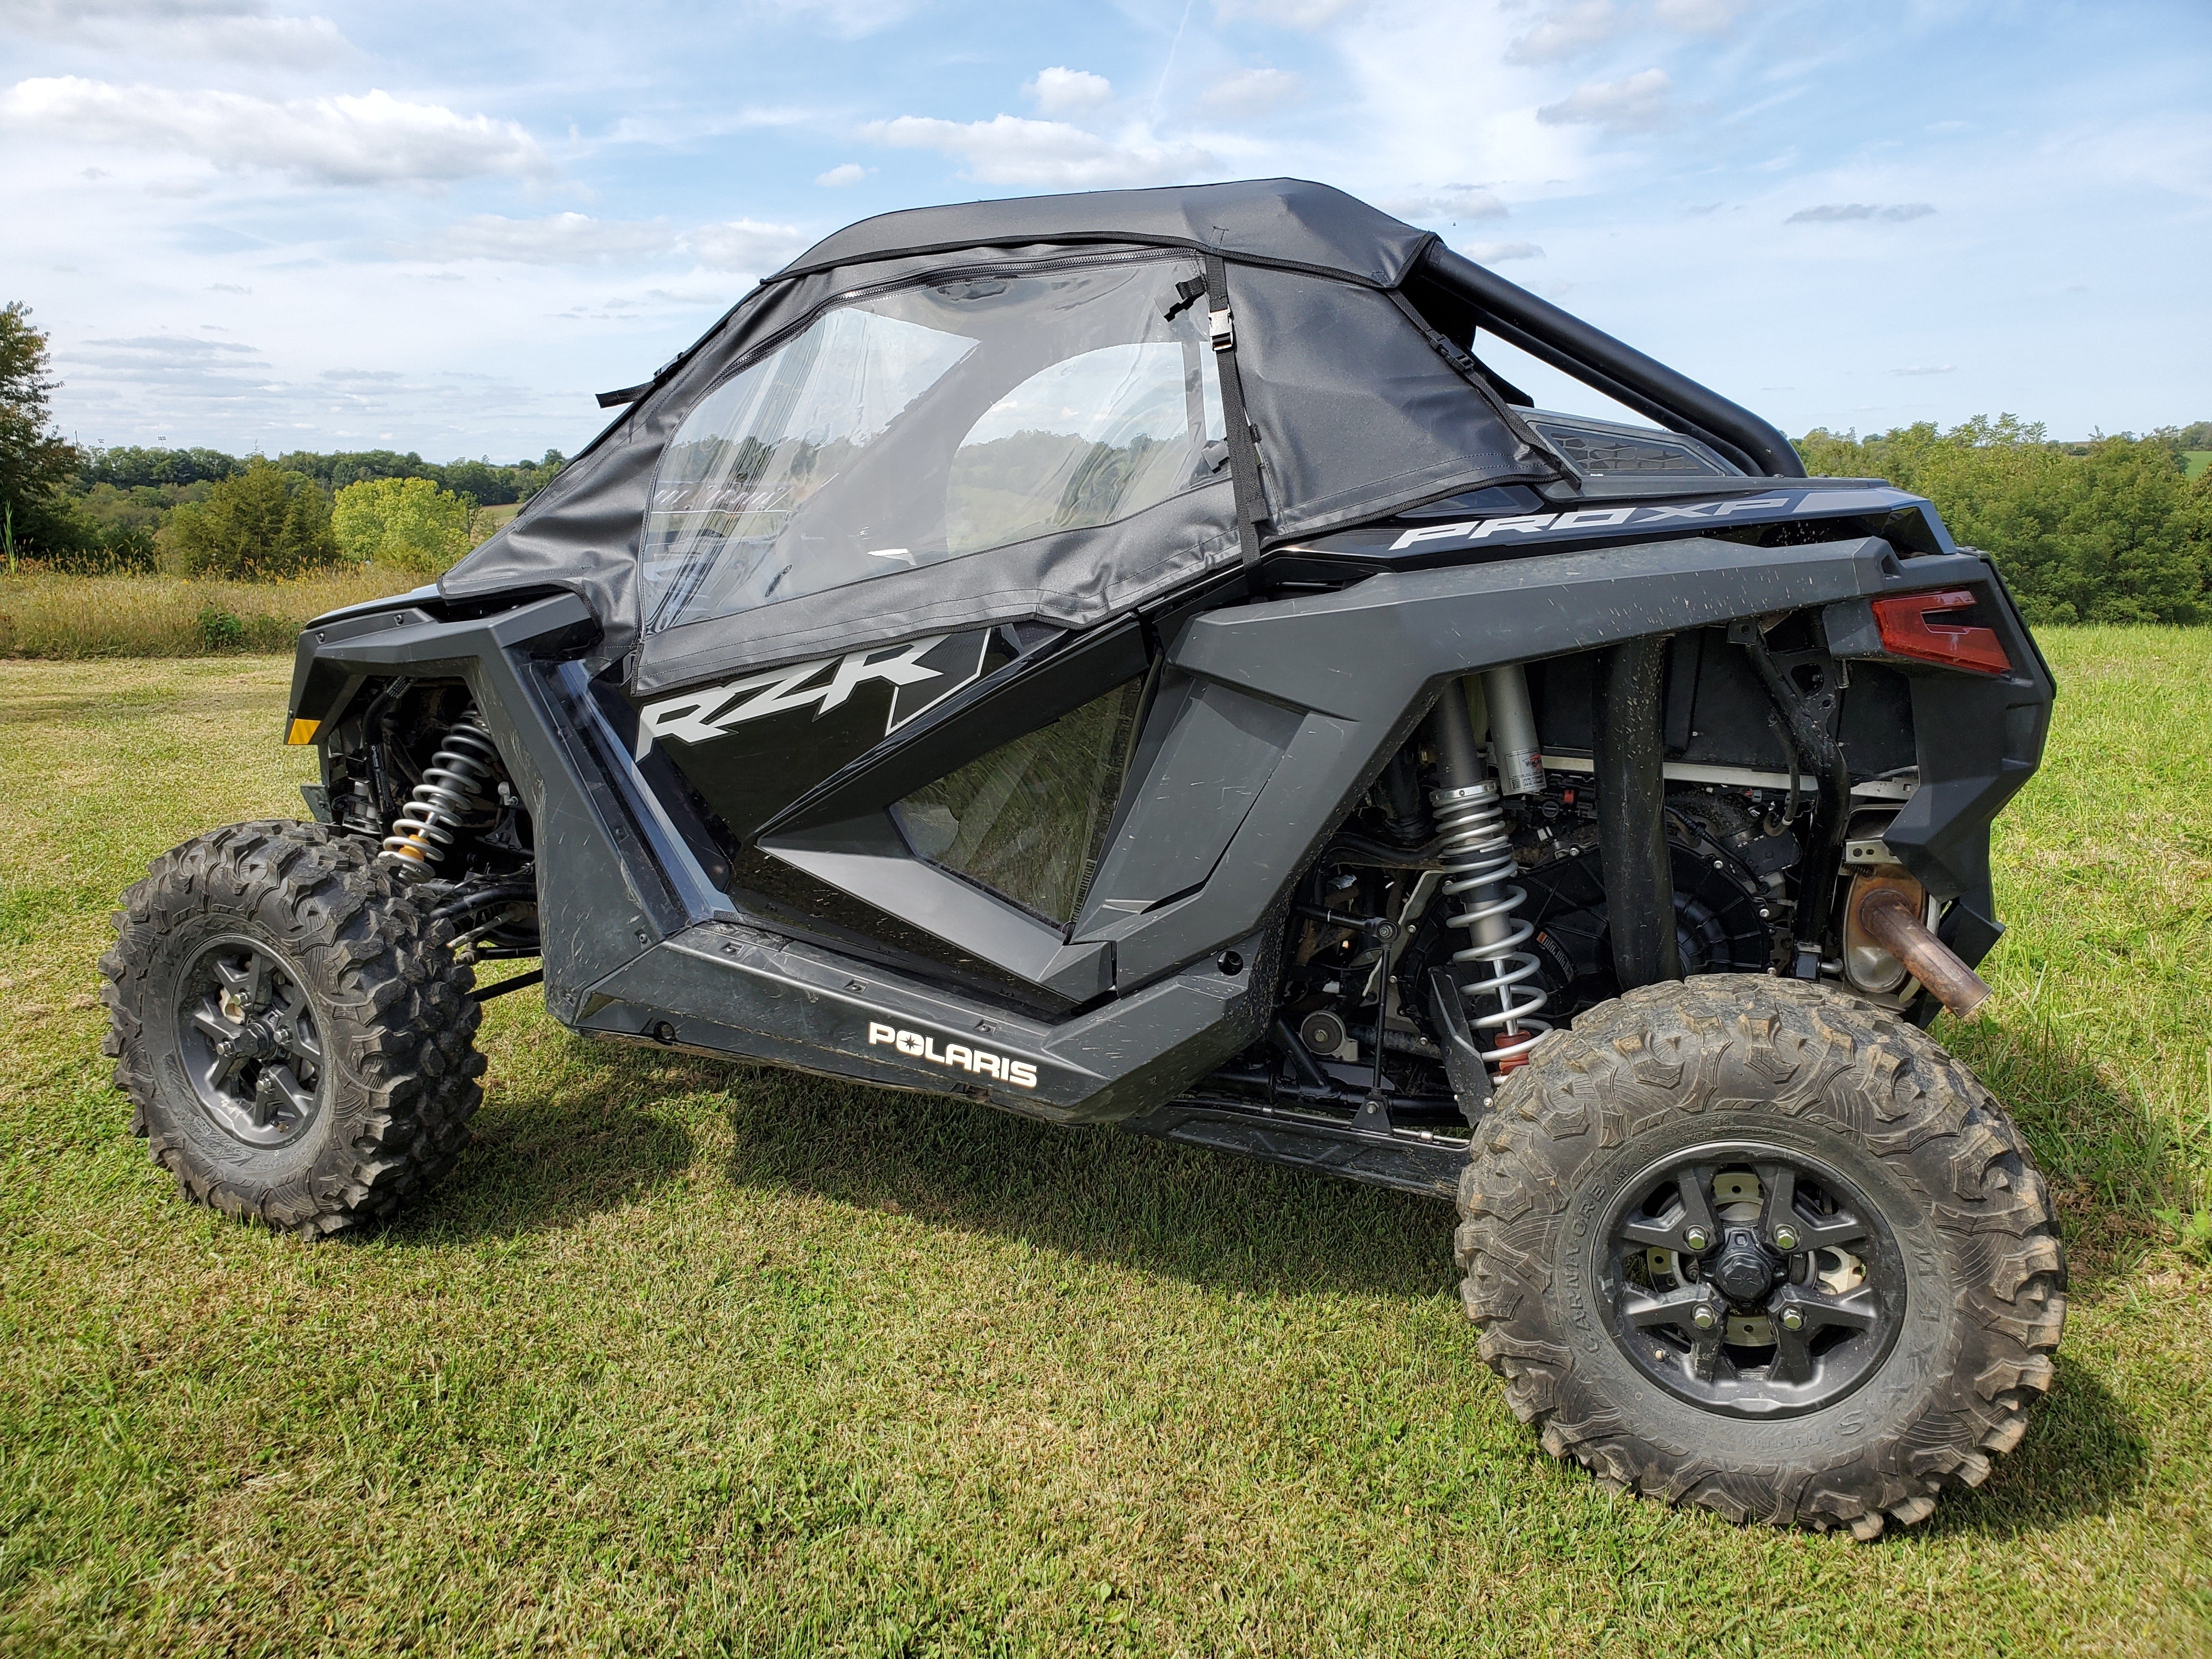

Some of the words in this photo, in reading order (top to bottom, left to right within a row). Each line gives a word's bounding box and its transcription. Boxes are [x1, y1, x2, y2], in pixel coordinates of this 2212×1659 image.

[1390, 507, 1637, 550] PRO
[1632, 497, 1790, 524] XP
[635, 634, 952, 763] RZR
[868, 1021, 1038, 1088] POLARIS
[1564, 1182, 1606, 1353] CARNIVORE
